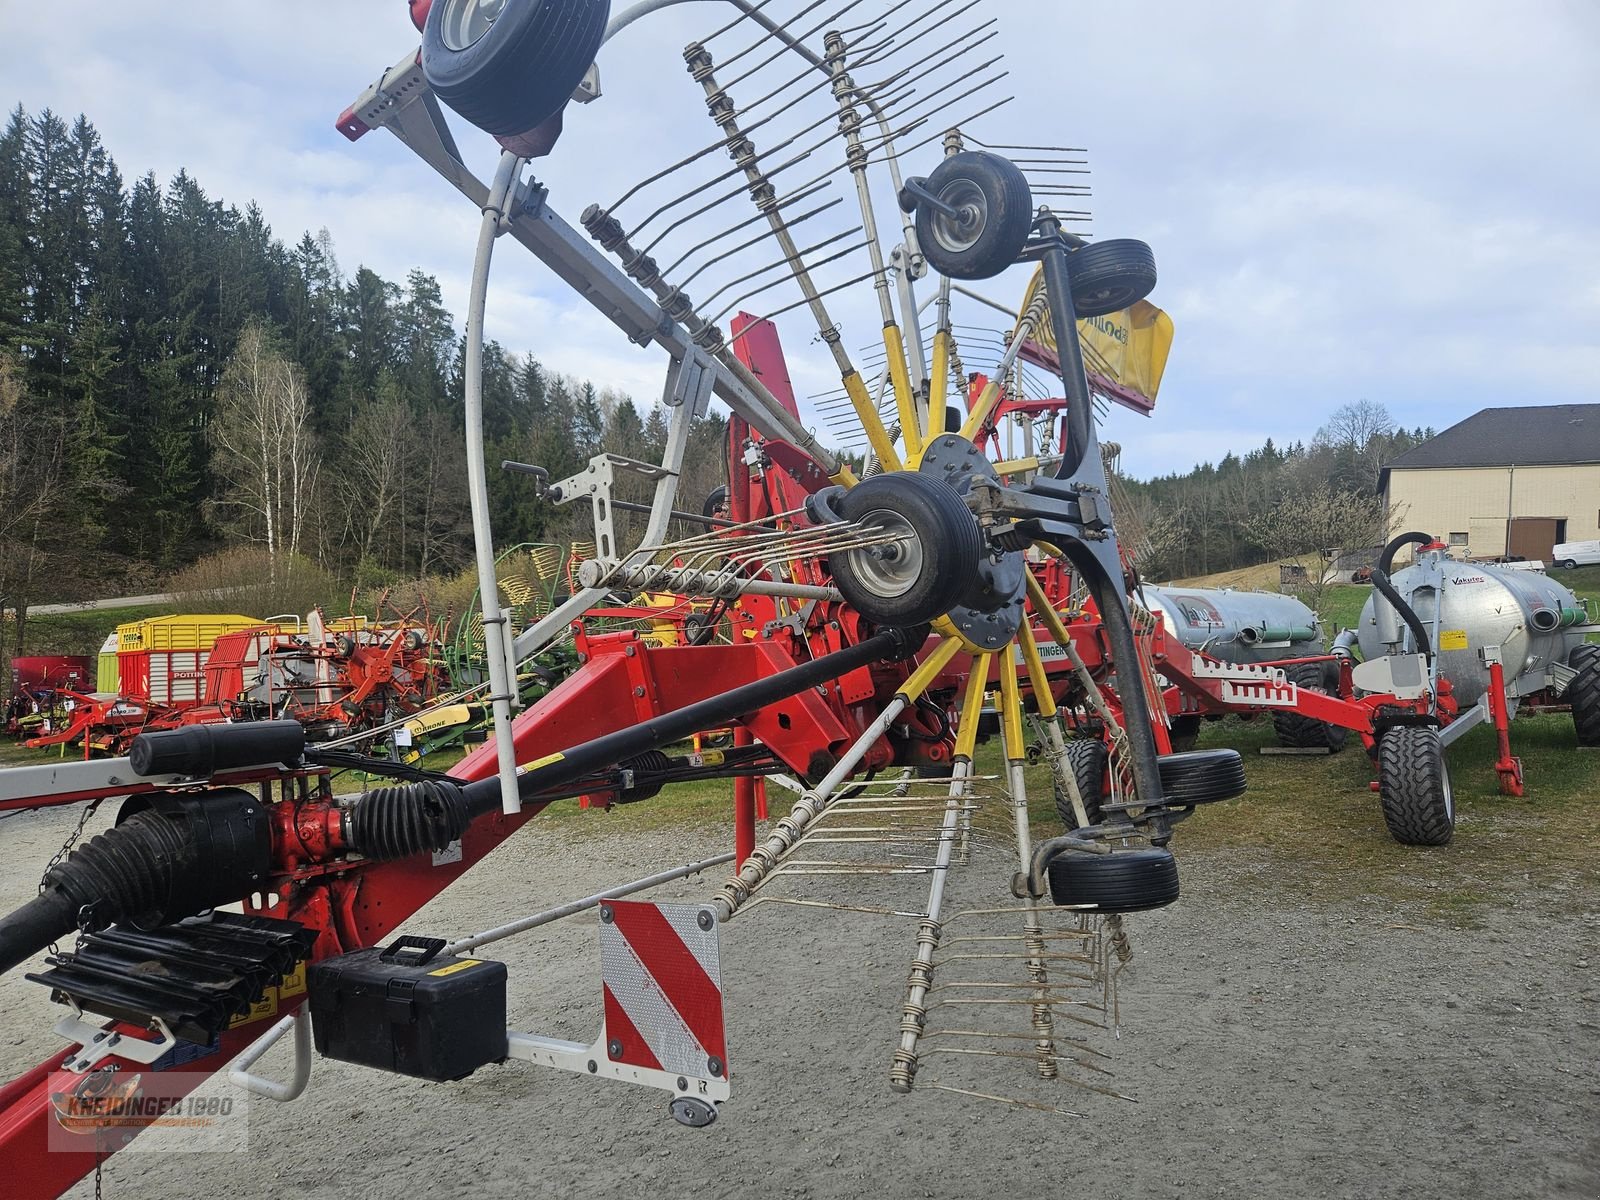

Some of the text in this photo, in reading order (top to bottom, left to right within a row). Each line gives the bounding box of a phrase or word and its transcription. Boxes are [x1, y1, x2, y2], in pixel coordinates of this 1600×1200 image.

[1452, 577, 1485, 585] Vakutec
[1037, 645, 1065, 657] TTINGER
[423, 720, 445, 732] KRONE
